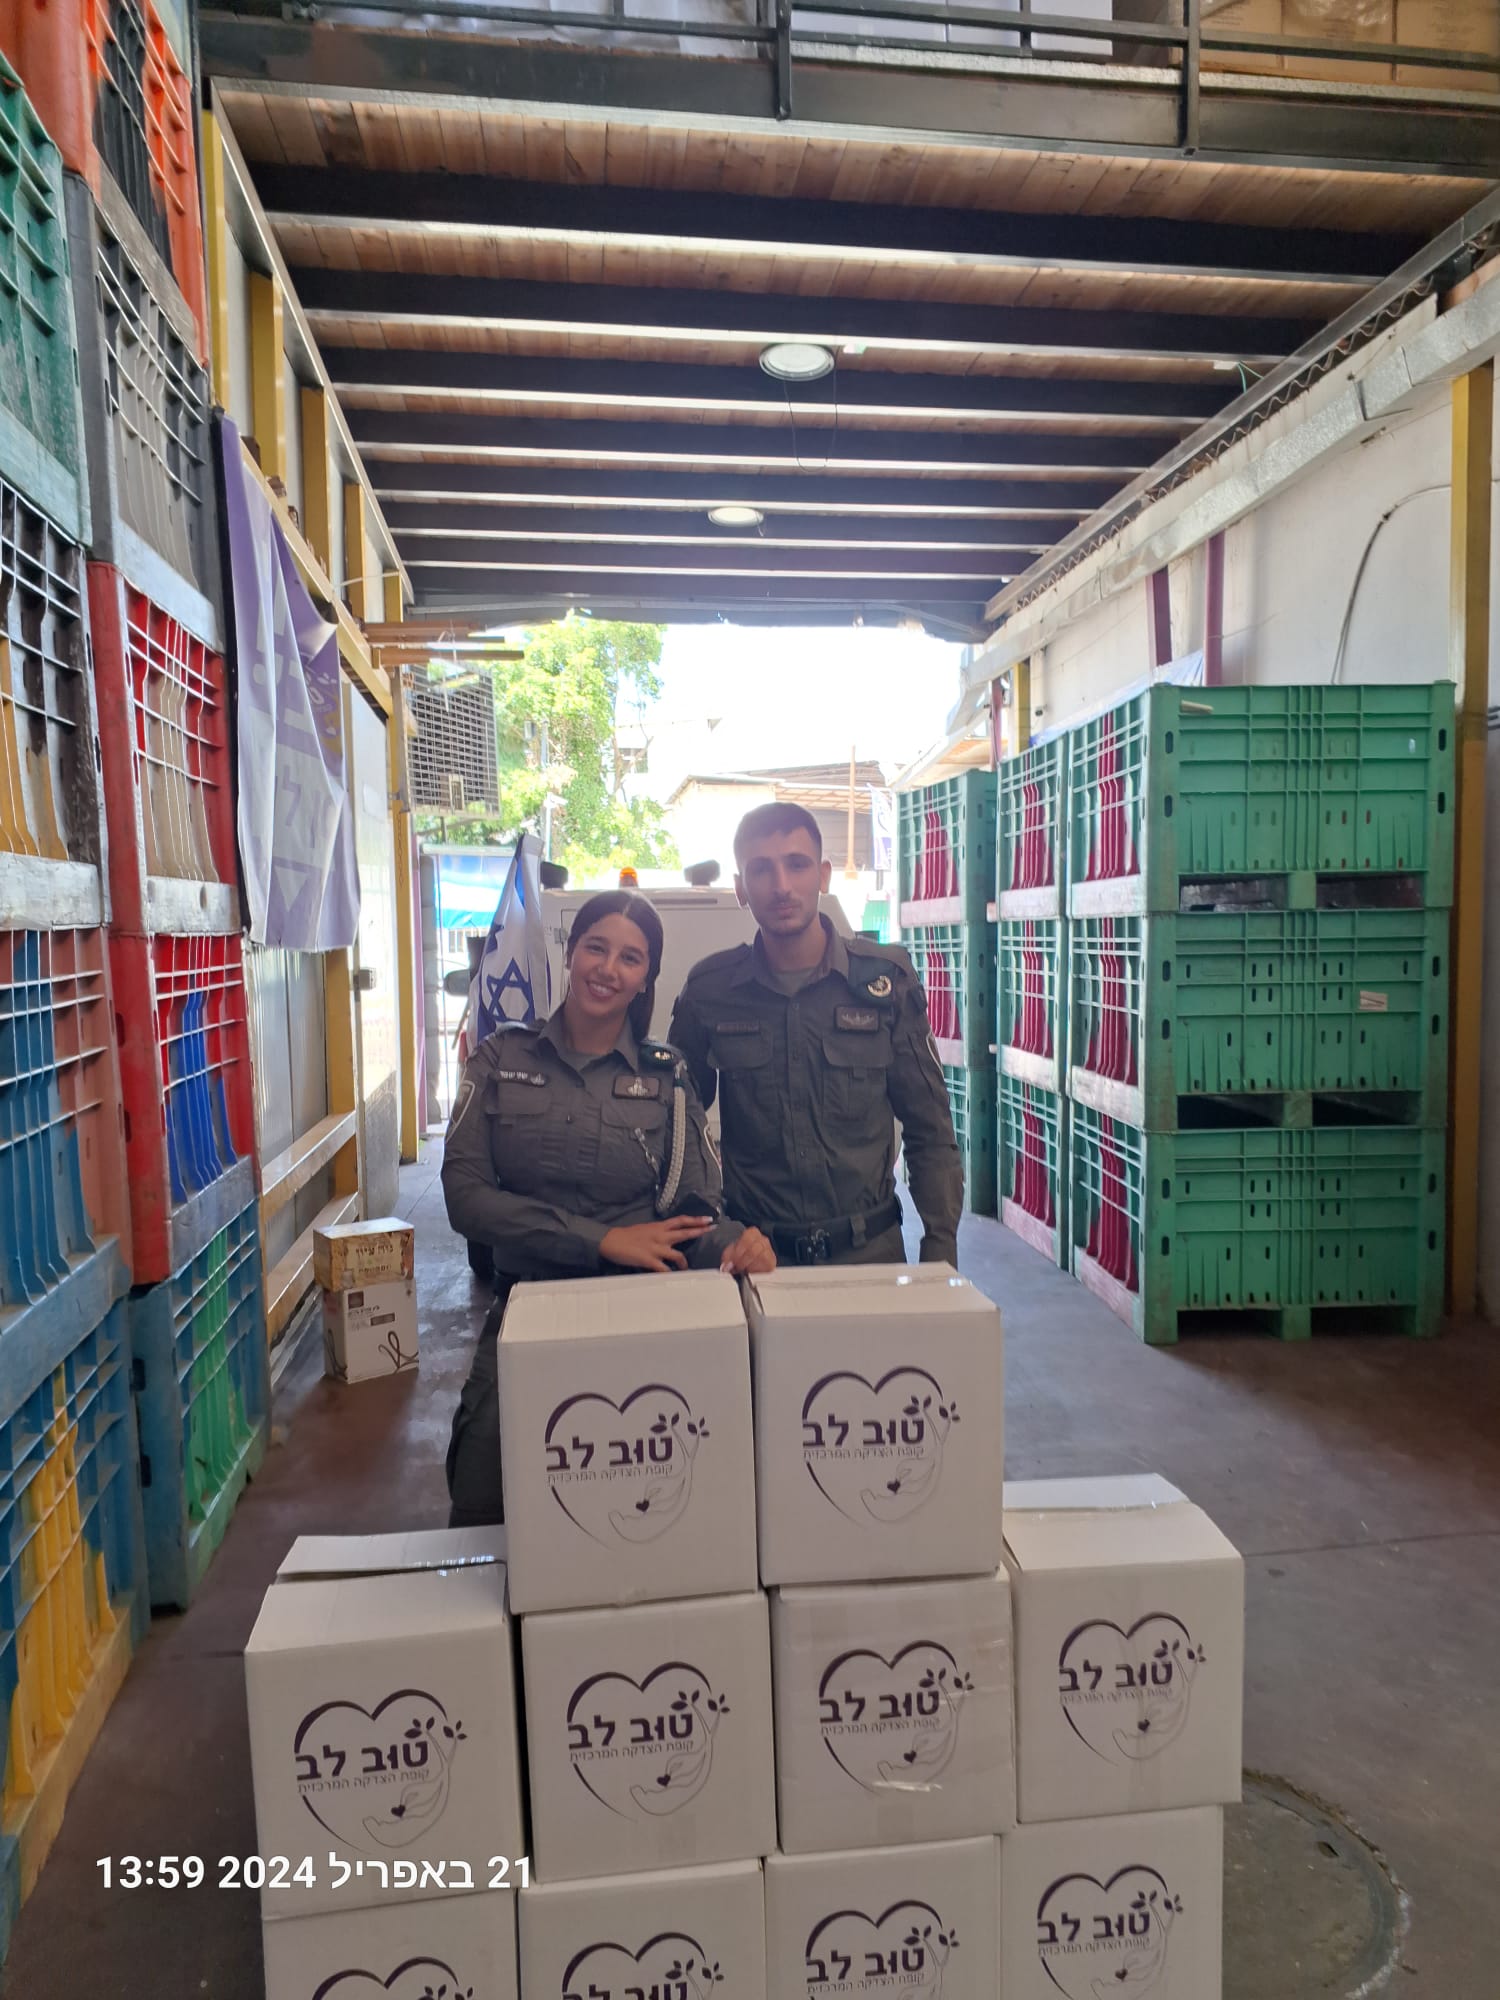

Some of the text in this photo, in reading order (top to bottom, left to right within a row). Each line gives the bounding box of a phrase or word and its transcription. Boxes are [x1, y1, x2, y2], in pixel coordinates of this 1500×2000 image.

[803, 1413, 849, 1447] לב
[546, 1435, 594, 1472] לב
[803, 1447, 924, 1461] קופת הצדקה המרכזית
[547, 1464, 673, 1486] קופת הצדקה המרכזית
[1059, 1660, 1102, 1692] לב
[819, 1690, 866, 1723] לב
[568, 1715, 616, 1750] לב
[295, 1744, 346, 1781] לב
[569, 1740, 694, 1763] קופת הצדקה המרכזית
[298, 1769, 430, 1794] קופת הצדקה המרכזית
[1037, 1912, 1080, 1944] לב
[806, 1950, 852, 1983] לב
